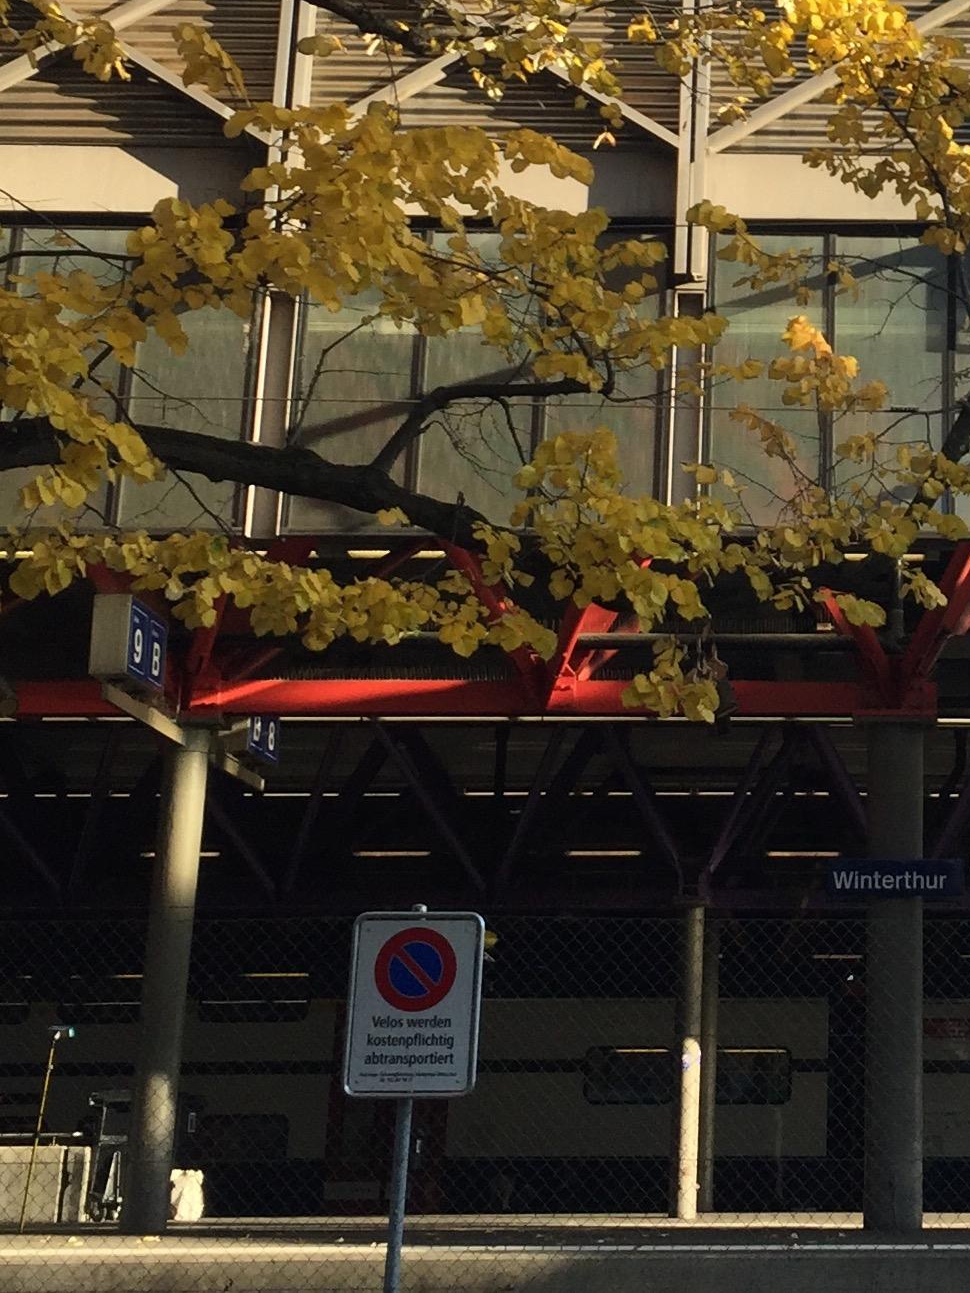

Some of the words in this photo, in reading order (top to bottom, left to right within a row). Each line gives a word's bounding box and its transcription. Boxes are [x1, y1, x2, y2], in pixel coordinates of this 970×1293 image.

[133, 629, 143, 664] 9
[152, 642, 161, 676] B
[253, 716, 261, 741] B
[268, 721, 276, 751] 8
[833, 871, 948, 889] Winterthur
[372, 1015, 403, 1028] Velos
[407, 1015, 452, 1028] werden
[366, 1033, 454, 1050] kostenpflichtig
[364, 1052, 454, 1068] abtransportiert
